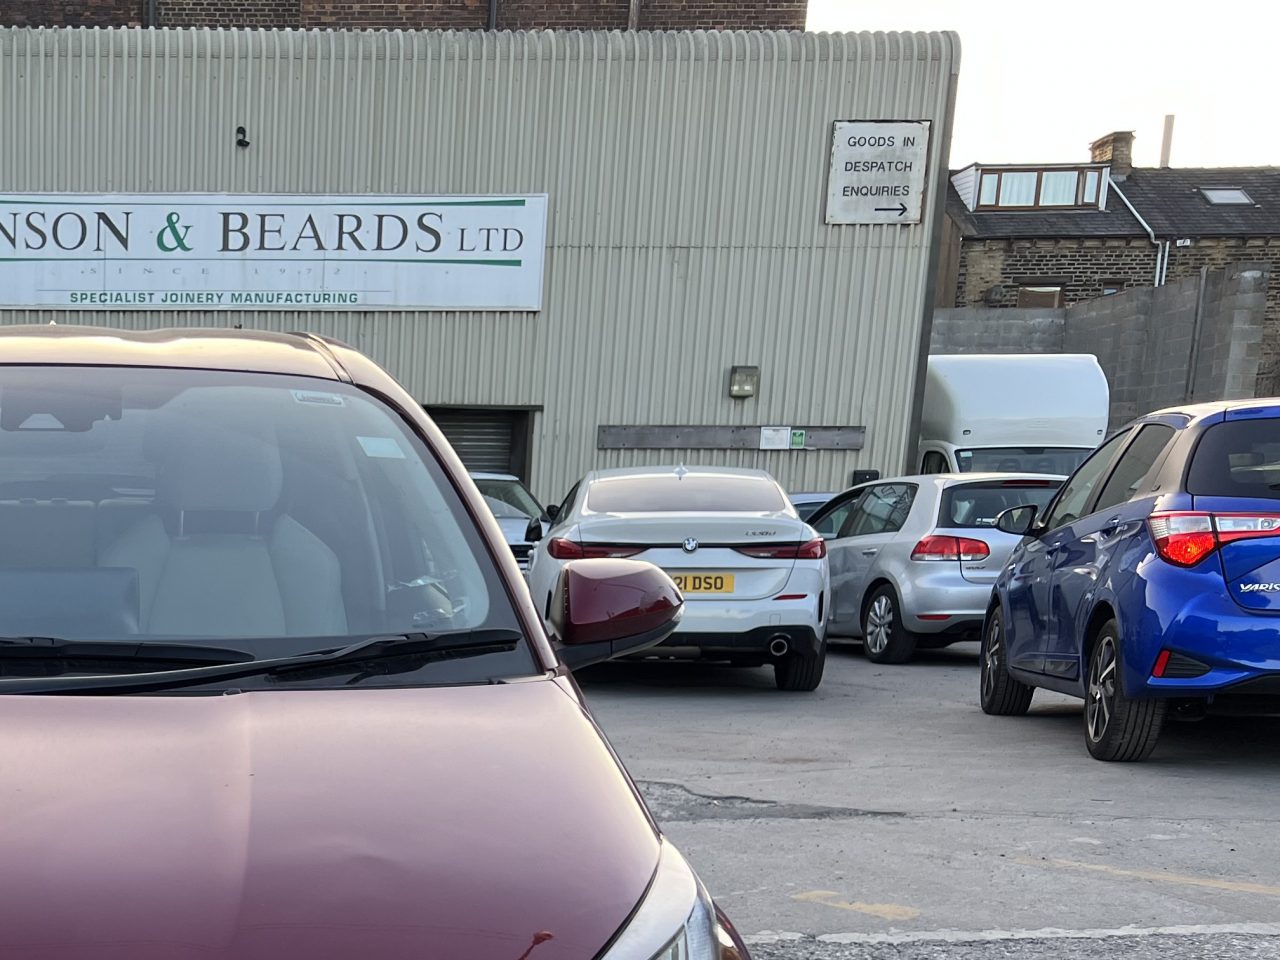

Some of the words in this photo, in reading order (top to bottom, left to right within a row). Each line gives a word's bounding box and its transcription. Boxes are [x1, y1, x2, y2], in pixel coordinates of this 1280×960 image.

[847, 136, 895, 147] GOODS
[903, 136, 915, 147] IN
[844, 161, 913, 172] DESPATCH
[842, 185, 910, 197] ENQUIRIES
[156, 211, 193, 252] &
[218, 212, 442, 253] BEARDS
[457, 227, 524, 252] LTD
[70, 292, 154, 303] SPECIALIST
[161, 292, 222, 303] JOINERY
[231, 292, 358, 304] MANUFACTURING
[692, 576, 723, 590] DSO
